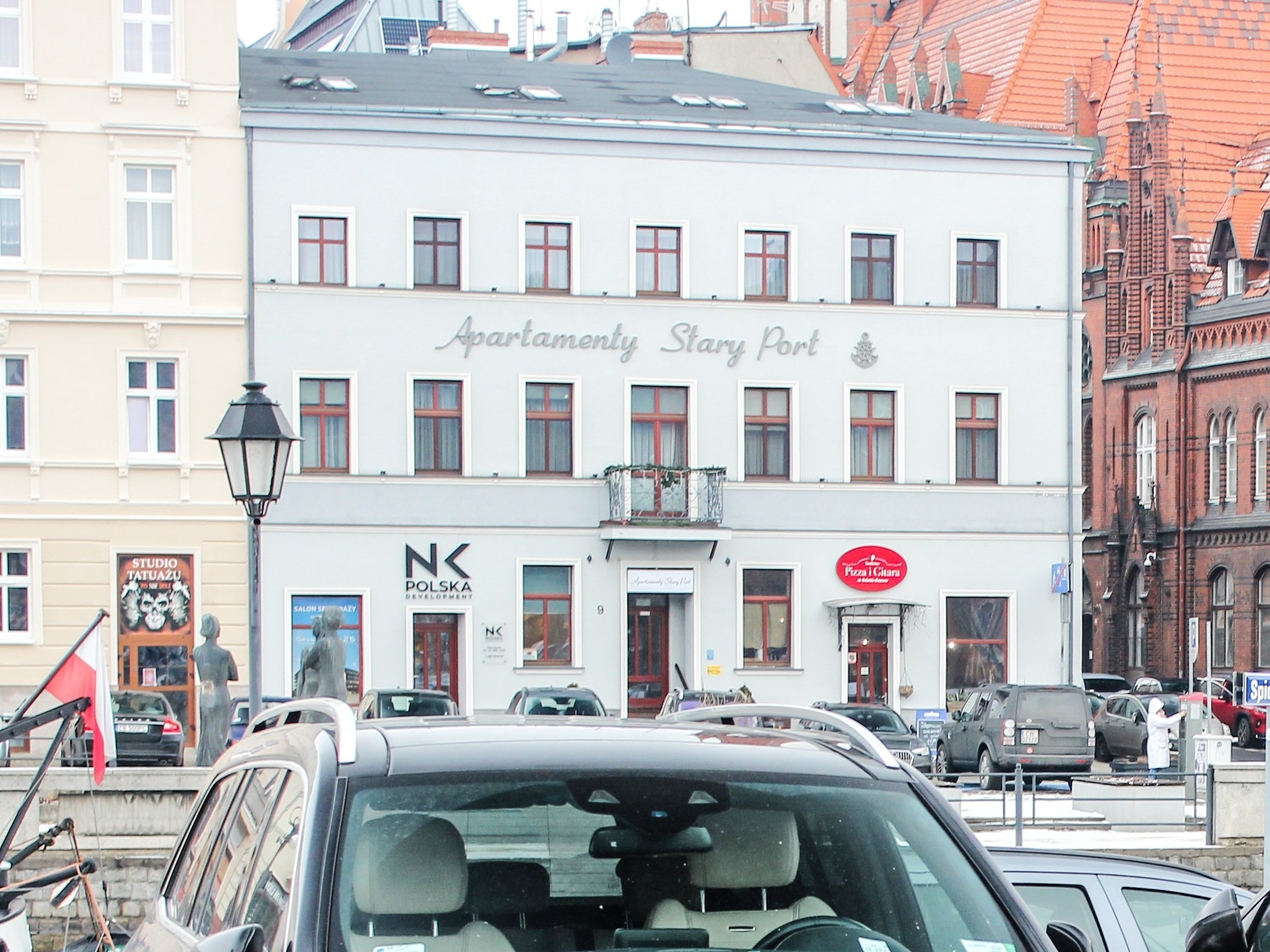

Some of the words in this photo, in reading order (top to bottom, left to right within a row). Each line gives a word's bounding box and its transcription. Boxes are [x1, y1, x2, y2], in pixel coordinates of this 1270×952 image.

[435, 315, 638, 363] Apartamenty
[660, 322, 746, 367] Stary
[757, 325, 819, 361] Port
[132, 558, 178, 569] STUDIO
[405, 543, 471, 578] NK
[127, 568, 182, 580] TATUAŻU
[845, 566, 867, 577] Pizza
[873, 566, 900, 577] Gitara
[405, 580, 472, 592] POLSKA
[293, 605, 317, 613] SALON
[597, 605, 605, 615] 9
